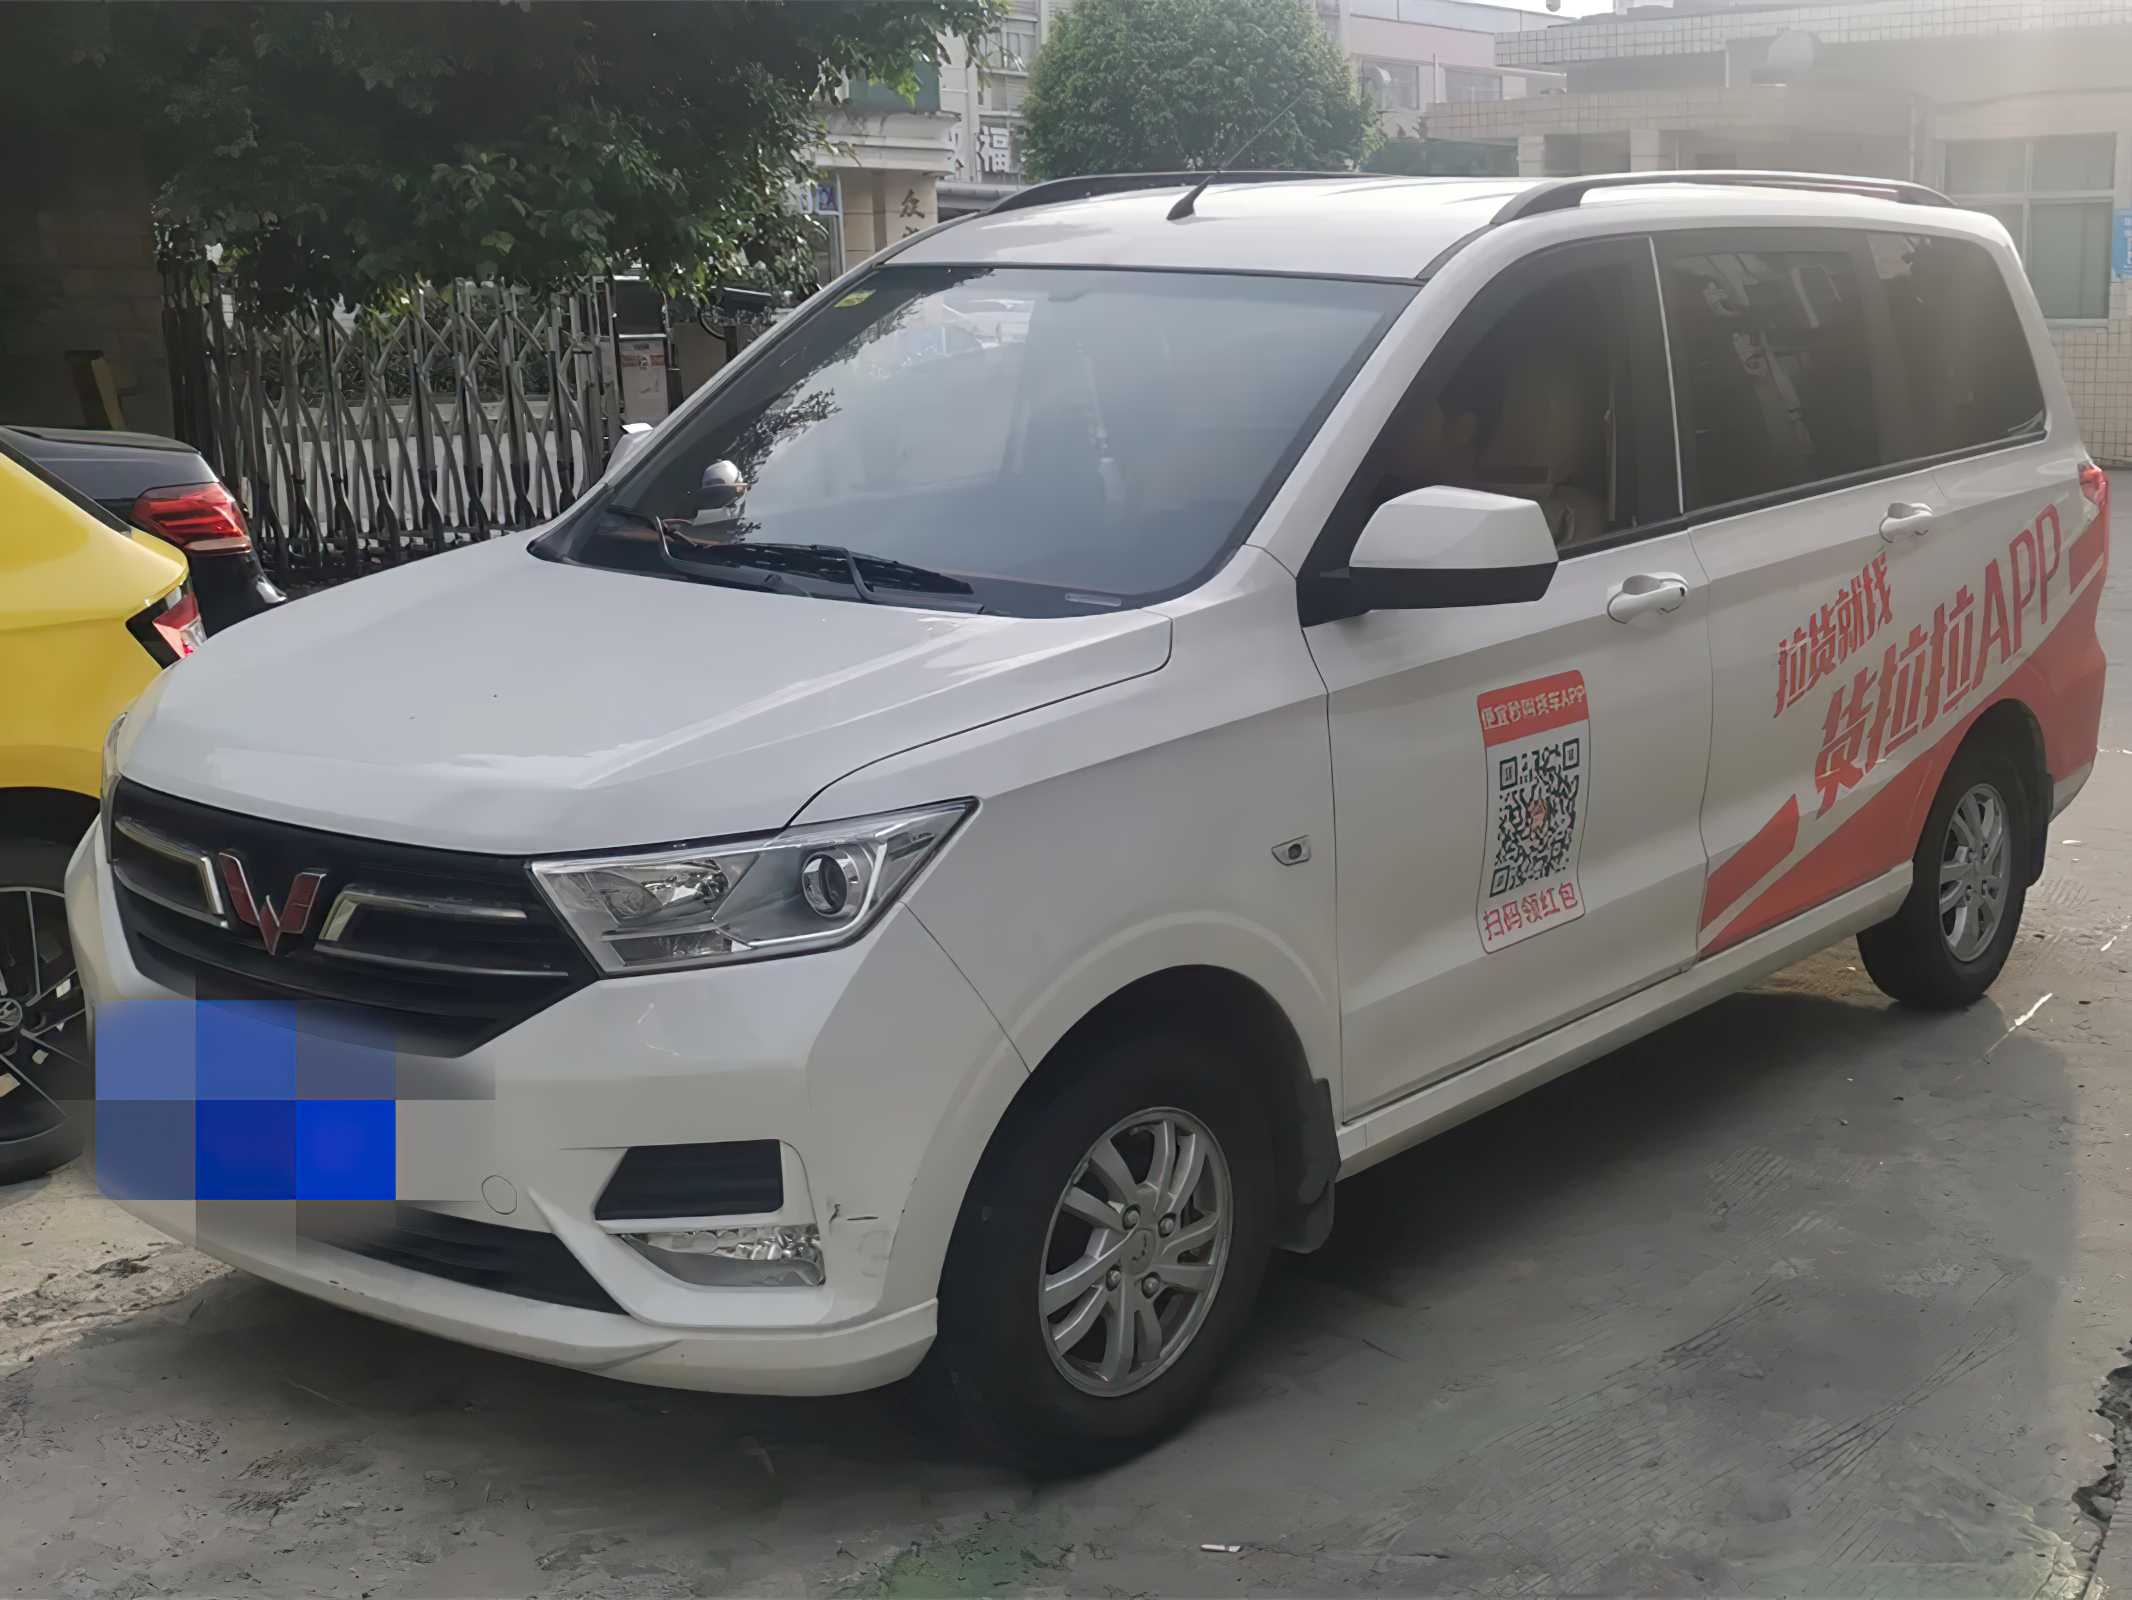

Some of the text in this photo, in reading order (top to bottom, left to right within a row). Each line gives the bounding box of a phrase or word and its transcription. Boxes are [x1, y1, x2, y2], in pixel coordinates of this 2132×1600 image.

[1773, 552, 1893, 719] 拉货就找
[1815, 503, 2062, 820] 货拉拉APP
[1484, 882, 1578, 941] 扫码领红包
